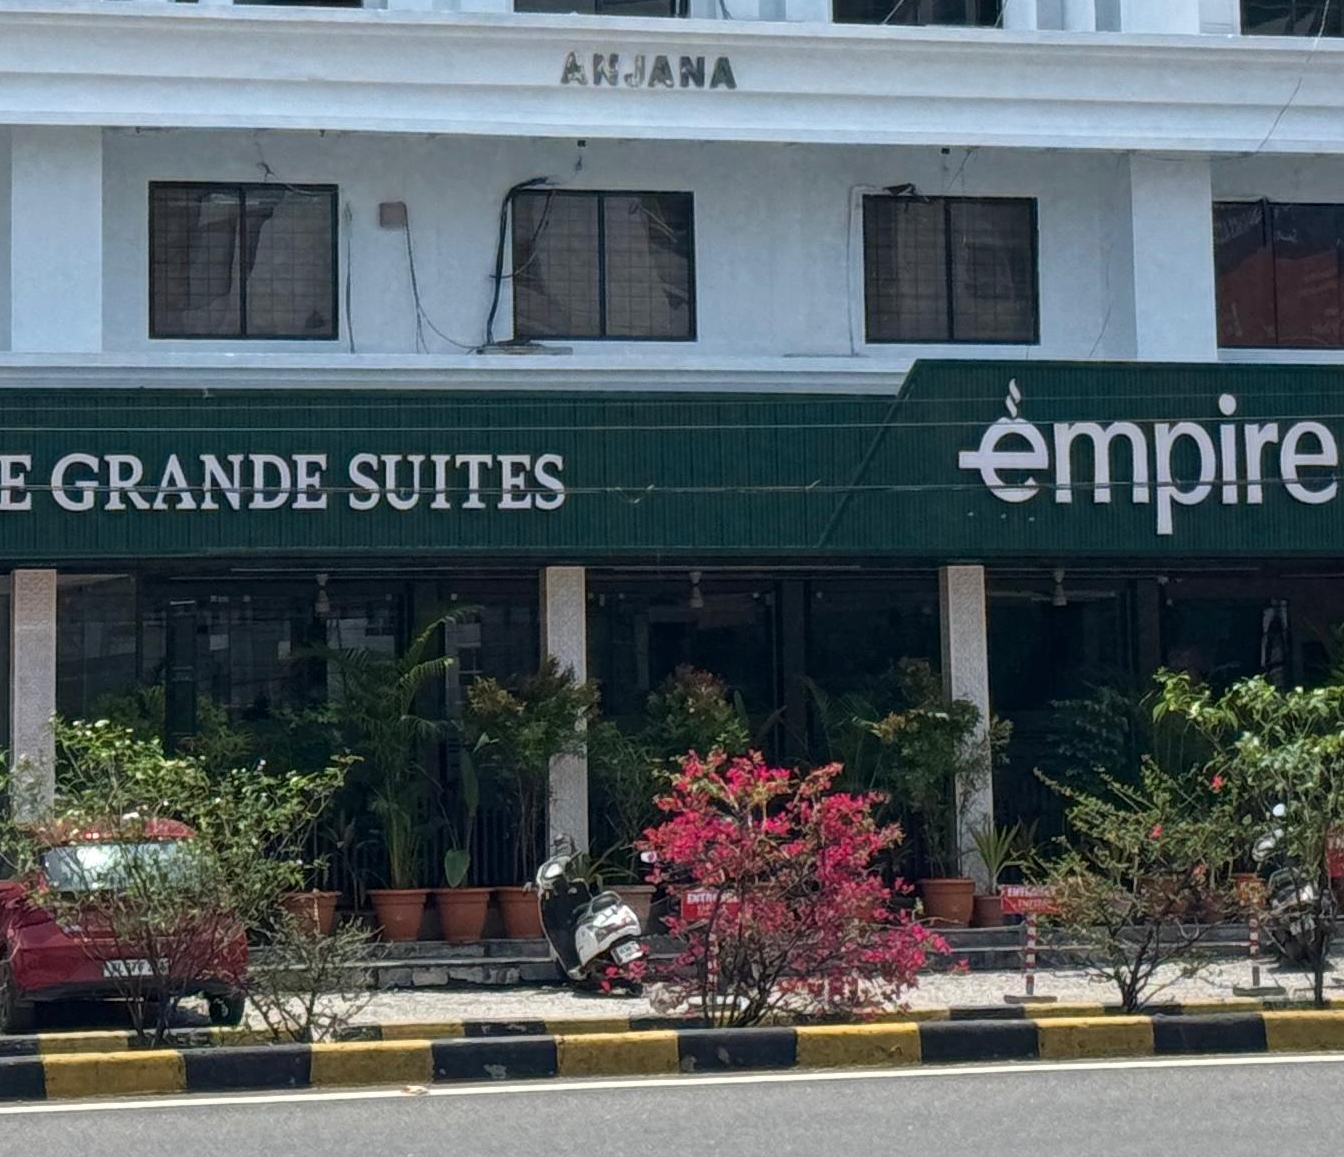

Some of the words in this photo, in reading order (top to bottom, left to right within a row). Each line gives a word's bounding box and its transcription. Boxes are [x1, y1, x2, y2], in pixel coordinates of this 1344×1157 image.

[560, 51, 738, 89] ANJANA
[50, 452, 328, 512] GRANDE
[348, 452, 566, 512] SUITES
